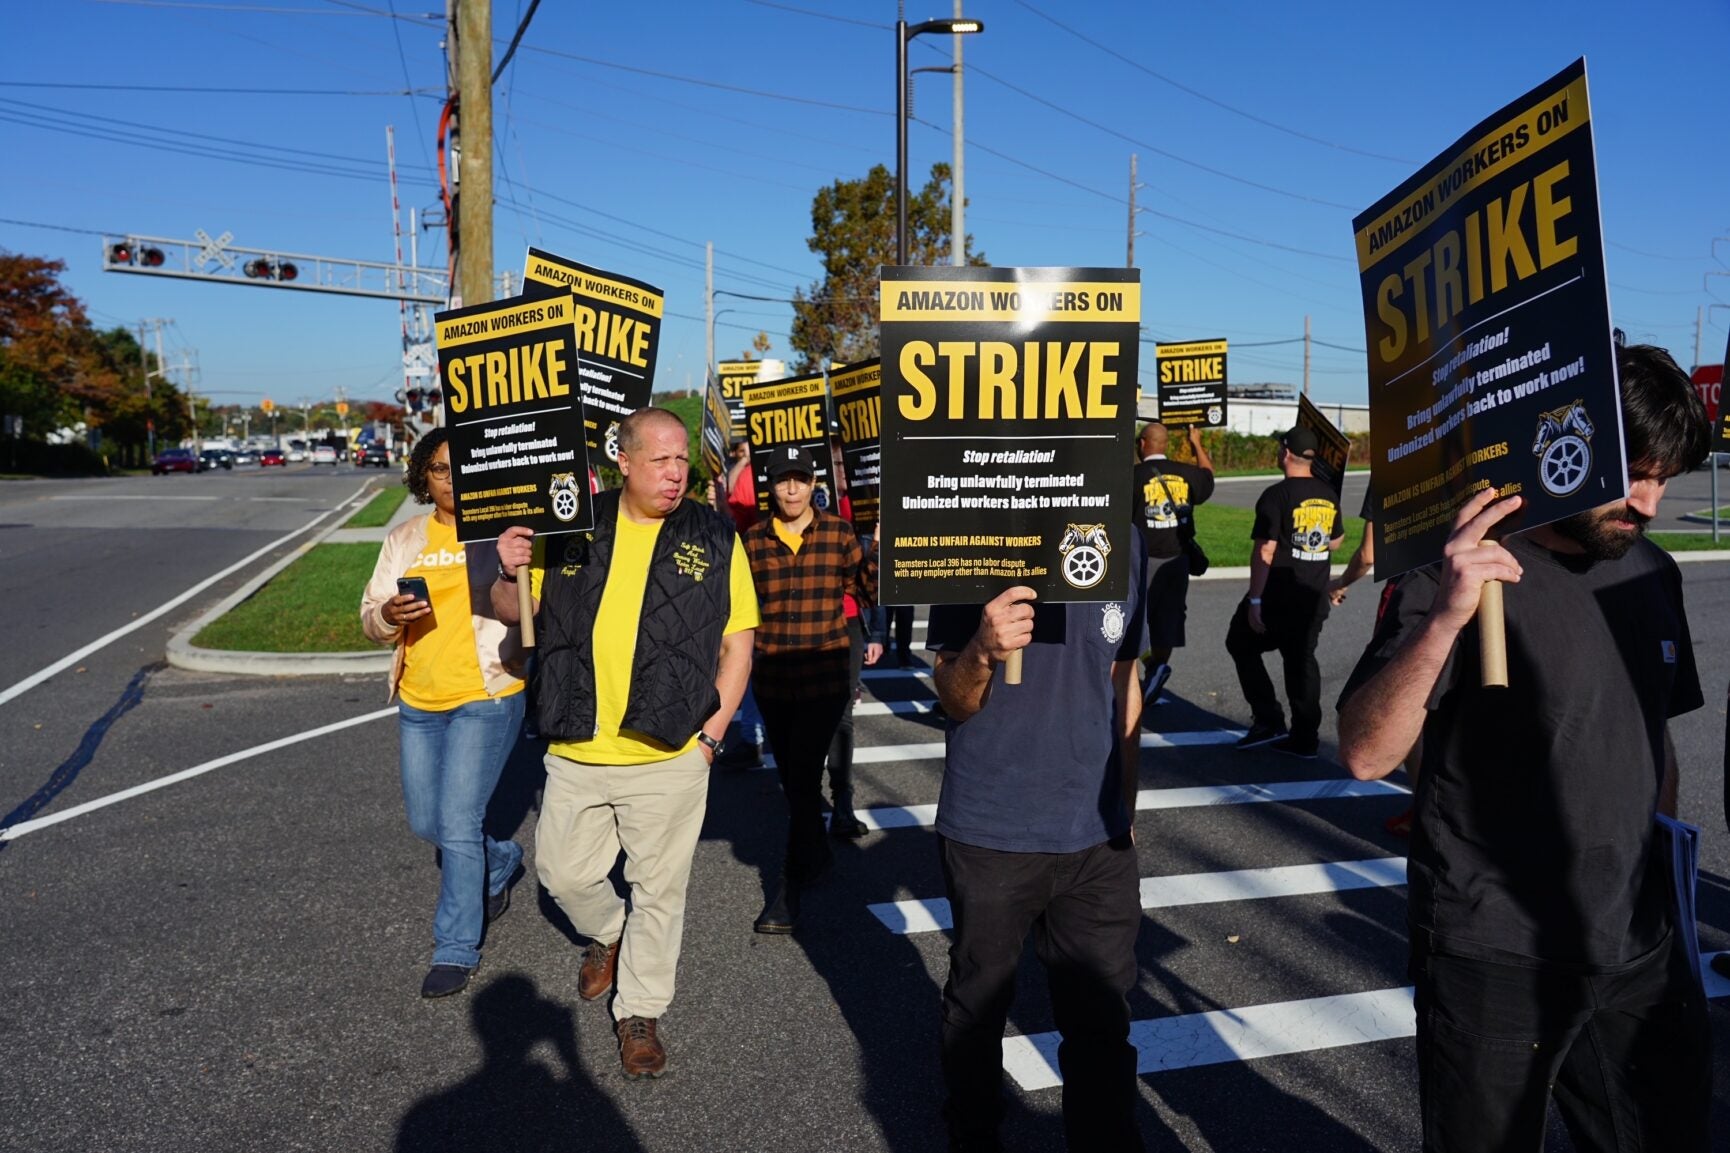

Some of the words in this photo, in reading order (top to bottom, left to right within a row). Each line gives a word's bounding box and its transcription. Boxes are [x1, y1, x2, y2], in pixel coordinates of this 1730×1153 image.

[1369, 190, 1435, 255] AMAZON
[1437, 124, 1530, 203] WORKERS
[1537, 99, 1568, 136] ON
[1377, 159, 1578, 364] STRIKE
[535, 263, 582, 288] AMAZON
[585, 278, 638, 304] WORKERS
[641, 295, 655, 310] ON
[896, 290, 985, 311] AMAZON
[991, 291, 1090, 312] WOERS
[1096, 292, 1123, 312] ON
[444, 320, 488, 341] AMAZON
[491, 307, 544, 331] WORKERS
[547, 304, 564, 320] ON
[575, 303, 652, 368] RIKE
[1432, 364, 1450, 386] Stop
[1450, 327, 1510, 374] retaliation!
[447, 339, 570, 413] STRIKE
[834, 374, 856, 390] AMAZON
[856, 369, 880, 386] WORKER
[898, 339, 1120, 421] STRIKE
[1160, 357, 1223, 383] STRIKE
[749, 391, 775, 402] AMAZON
[776, 387, 808, 398] WORKERS
[809, 383, 820, 393] ON
[1407, 408, 1432, 430] Bring
[1433, 376, 1475, 416] unlawfully
[1476, 342, 1550, 387] terminated
[1696, 382, 1722, 405] TO
[839, 395, 880, 444] STRI
[1388, 429, 1435, 463] Unionized
[1435, 411, 1466, 441] workers
[1467, 392, 1496, 419] back
[1497, 388, 1512, 404] to
[1513, 372, 1549, 400] work
[1550, 356, 1585, 386] now!
[484, 428, 498, 439] Stop
[498, 421, 536, 437] retaliation!
[750, 403, 823, 446] STRIKE
[517, 436, 558, 451] terminated
[488, 458, 512, 470] workers
[512, 455, 530, 467] back
[529, 455, 539, 465] to
[538, 452, 557, 463] work
[557, 449, 575, 461] now!
[963, 450, 991, 465] Stop
[991, 449, 1055, 464] retaliation!
[927, 475, 959, 490] Bring
[960, 474, 1022, 491] unlawfully
[1024, 473, 1084, 488] terminated
[1383, 488, 1412, 510] AMAZON
[1412, 485, 1420, 497] IS
[1466, 441, 1509, 467] WORKERS
[512, 483, 538, 494] WORKERS
[1500, 482, 1522, 498] allies
[902, 496, 960, 510] Unionized
[960, 495, 1009, 509] workers
[1010, 495, 1038, 509] back
[1039, 496, 1050, 508] to
[1051, 494, 1080, 508] work
[1080, 494, 1110, 507] now!
[894, 536, 929, 548] AMAZON
[929, 536, 938, 547] IS
[939, 536, 969, 547] UNFAIR
[969, 536, 1004, 547] AGAINST
[1005, 535, 1042, 547] WORKERS
[894, 559, 928, 568] Teamsters
[929, 558, 946, 568] Local
[947, 558, 960, 567] 396
[960, 559, 973, 567] has
[982, 558, 1000, 567] labor
[1001, 559, 1025, 569] dispute
[894, 568, 910, 578] with
[910, 570, 923, 579] any
[923, 569, 954, 579] employer
[955, 567, 972, 577] other
[973, 567, 988, 577] than
[989, 568, 1016, 577] Amazon
[1016, 568, 1022, 576] &
[1022, 568, 1030, 576] its
[1031, 566, 1047, 576] allies
[1101, 602, 1122, 614] LOCAL
